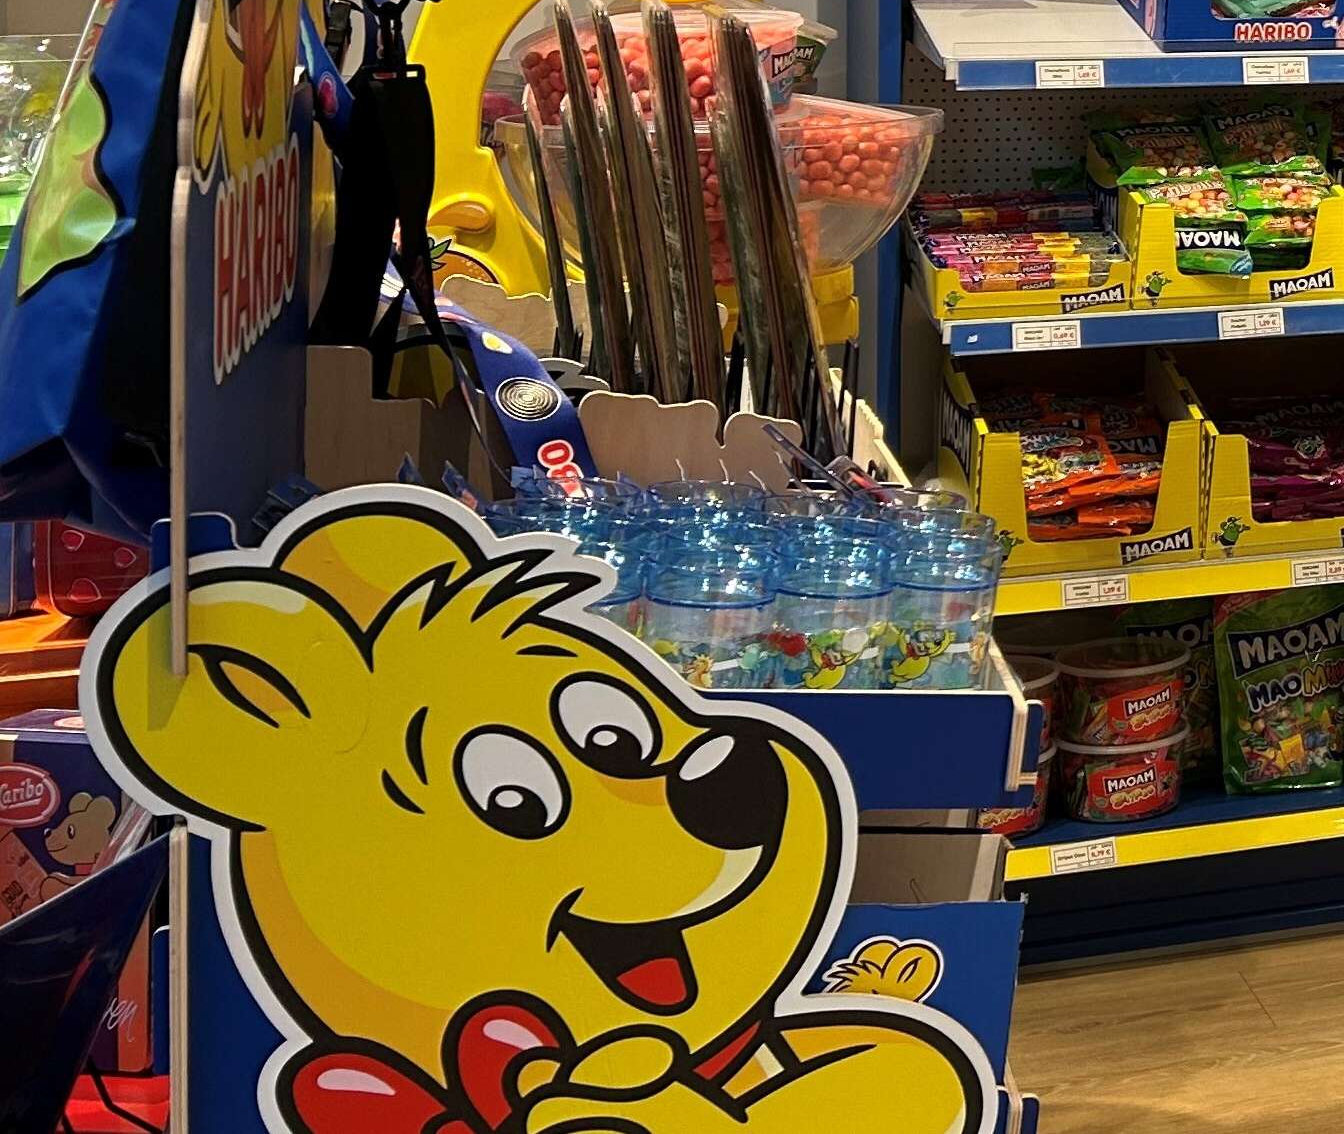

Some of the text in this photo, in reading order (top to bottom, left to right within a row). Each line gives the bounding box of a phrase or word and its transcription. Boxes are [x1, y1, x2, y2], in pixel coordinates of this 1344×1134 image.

[1234, 21, 1312, 43] HARIBO
[216, 142, 298, 380] HARIBO
[1273, 271, 1332, 296] MAOAM
[1062, 287, 1125, 313] MAOAM
[1125, 532, 1190, 561] MAOAM
[1128, 687, 1171, 714] MAOAM
[1108, 768, 1155, 792] MAOAM
